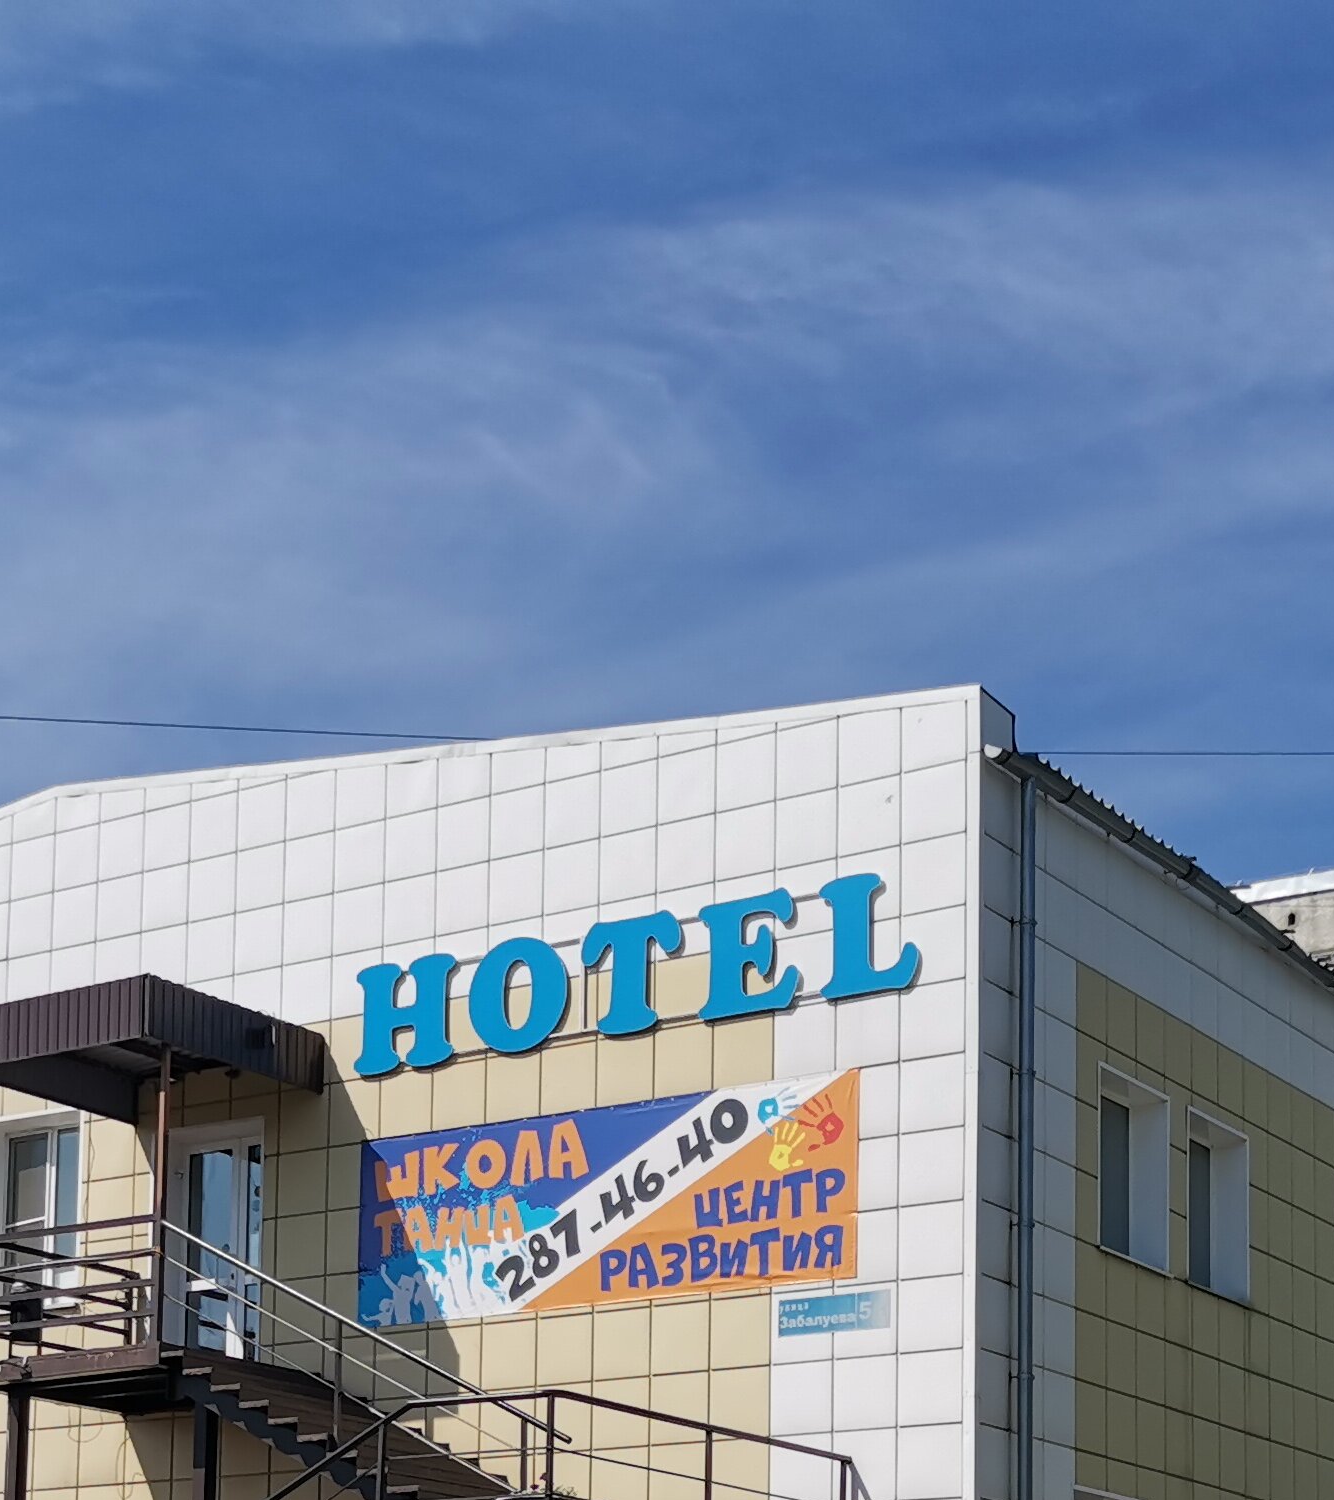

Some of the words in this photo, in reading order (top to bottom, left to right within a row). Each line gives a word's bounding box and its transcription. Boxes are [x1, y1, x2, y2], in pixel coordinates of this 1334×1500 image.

[354, 872, 920, 1077] HOTEL
[375, 1119, 589, 1201] ШКОЛА
[374, 1193, 525, 1257] ТАНЦА
[693, 1168, 846, 1229] ЦЕНТР
[599, 1224, 844, 1292] РАЗВИТИЯ
[779, 1313, 856, 1329] Забалуева
